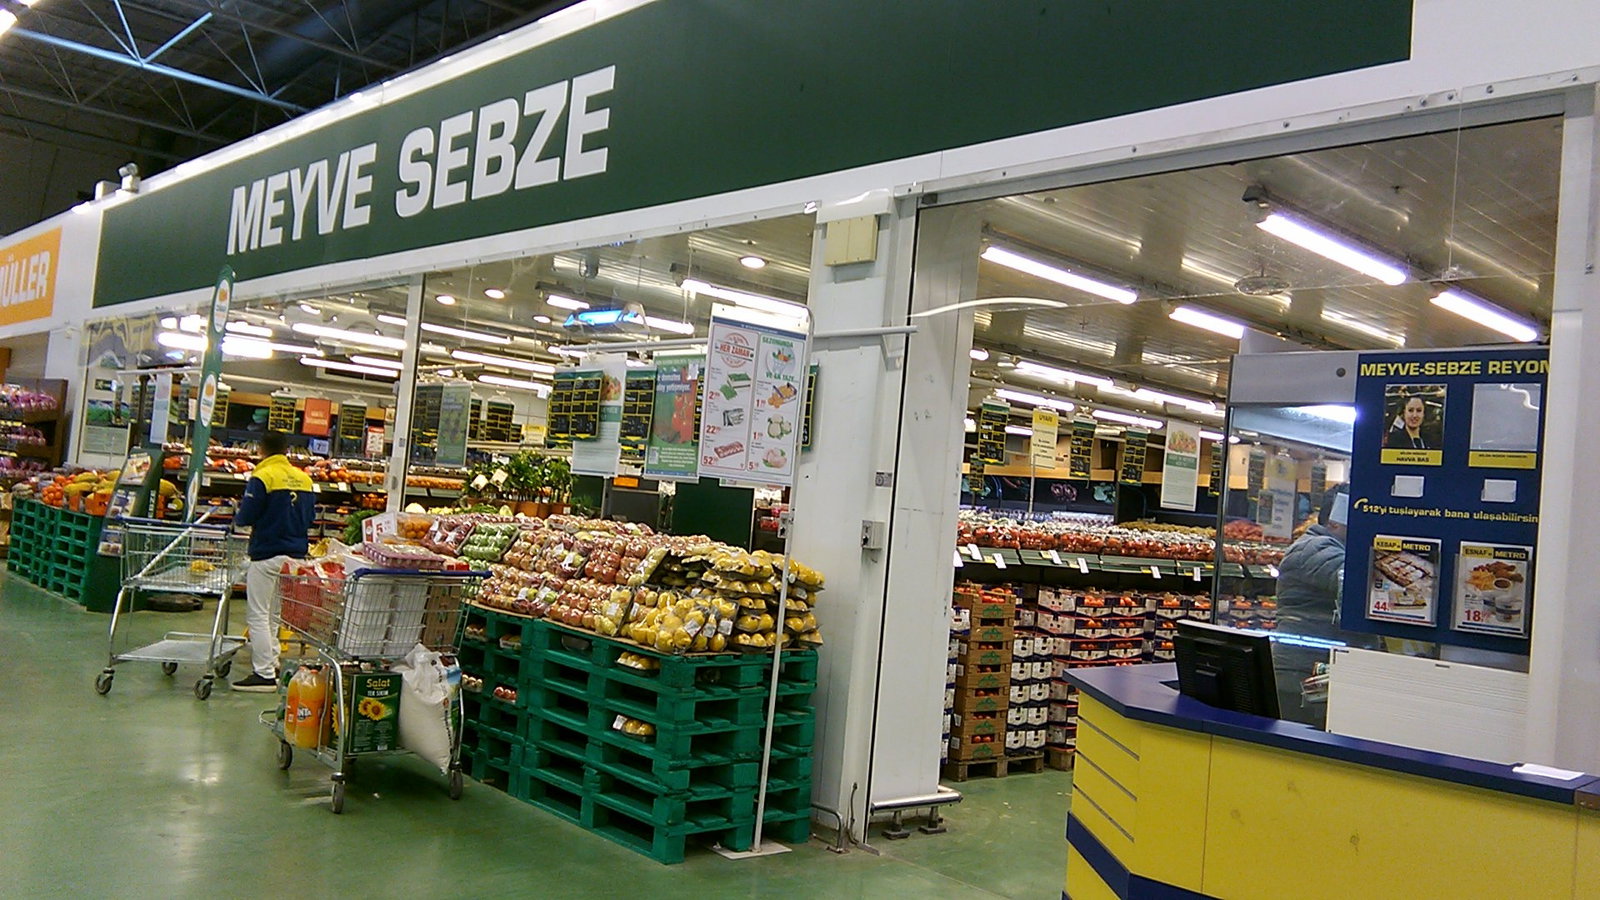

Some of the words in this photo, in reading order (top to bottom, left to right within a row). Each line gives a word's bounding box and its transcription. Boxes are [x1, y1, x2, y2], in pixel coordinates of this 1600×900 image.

[226, 143, 377, 255] MEYVE
[395, 64, 616, 218] SEBZE
[0, 250, 51, 308] ÜLLER
[1359, 361, 1482, 377] MEYVE-SEBZE
[1363, 504, 1387, 516] 512'yi
[1388, 506, 1441, 518] tuşlayarak
[1444, 508, 1470, 519] bana
[1402, 543, 1431, 552] METRO
[1464, 548, 1488, 556] ESNAF
[1494, 551, 1526, 560] METRO
[366, 678, 391, 688] Salat
[297, 707, 312, 717] NTA
